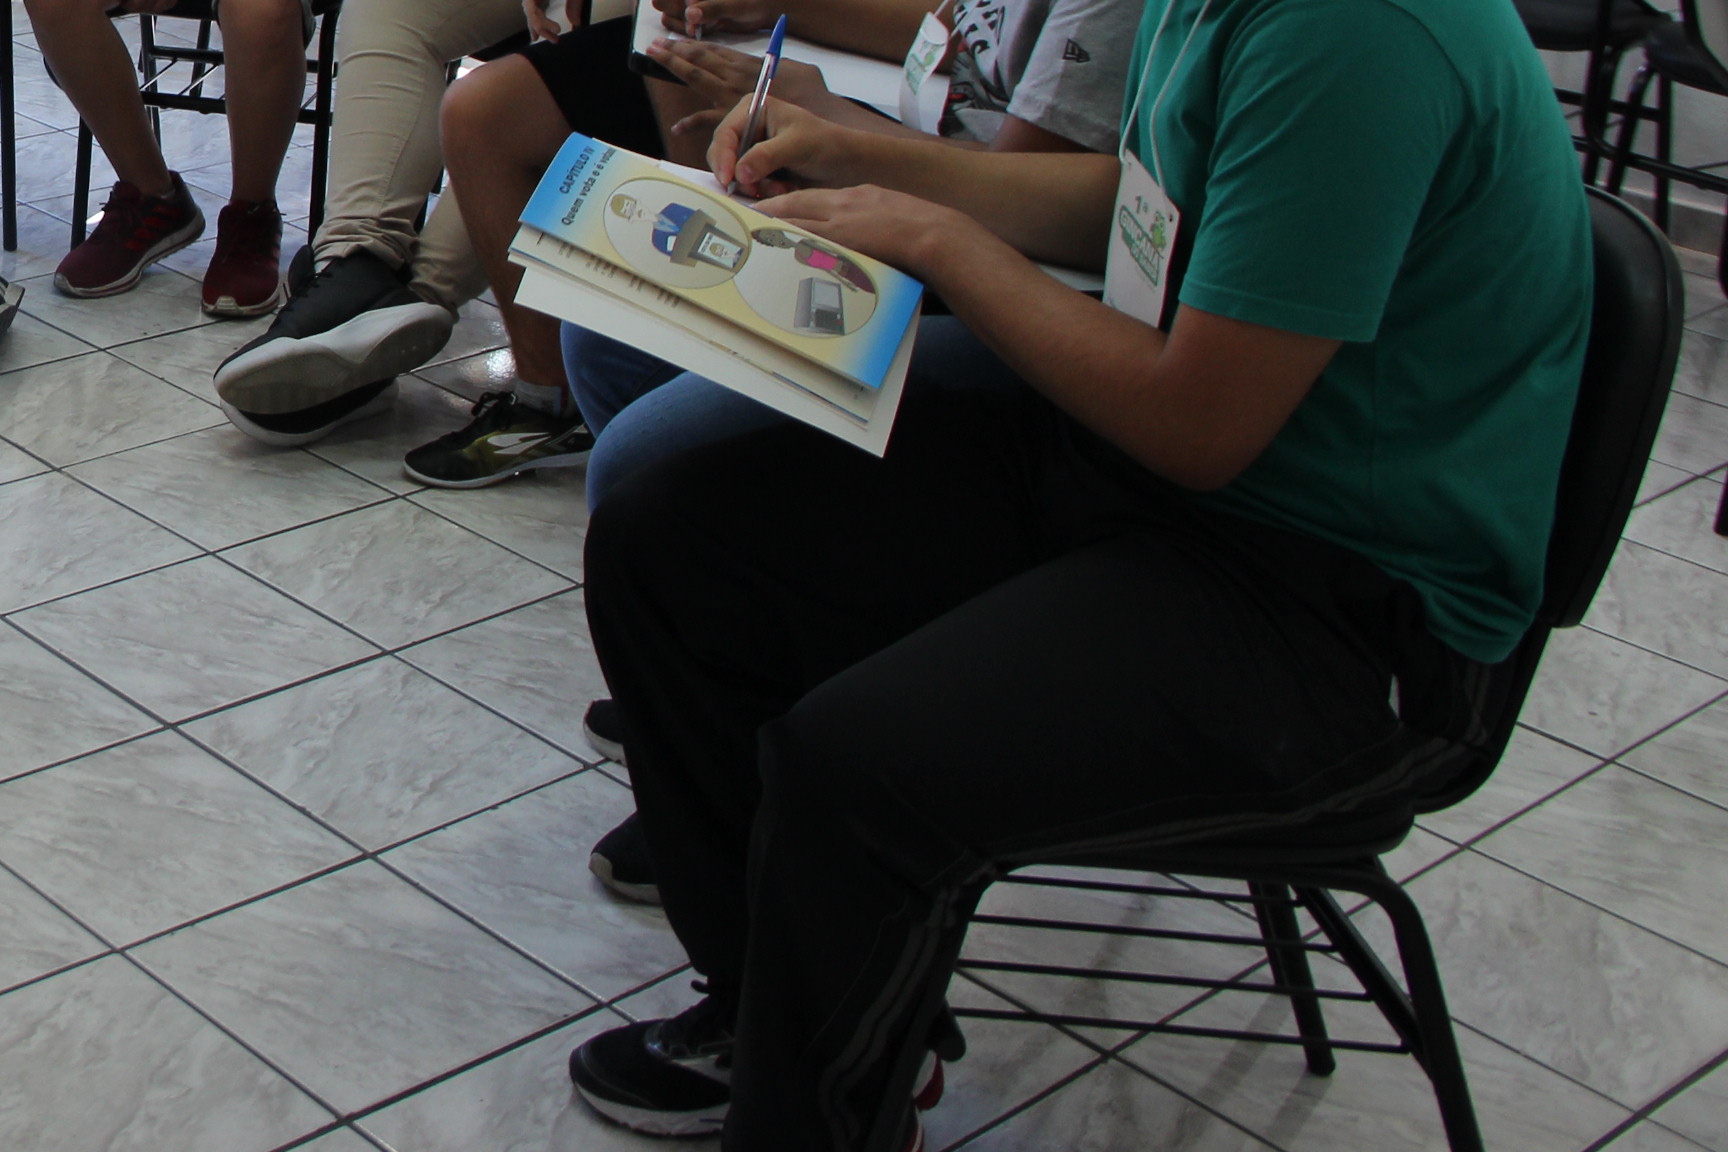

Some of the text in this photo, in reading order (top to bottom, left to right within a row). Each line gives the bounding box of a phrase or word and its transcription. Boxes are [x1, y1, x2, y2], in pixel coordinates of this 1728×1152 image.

[561, 197, 584, 226] Quem
[579, 176, 597, 197] vota
[592, 169, 600, 177] e
